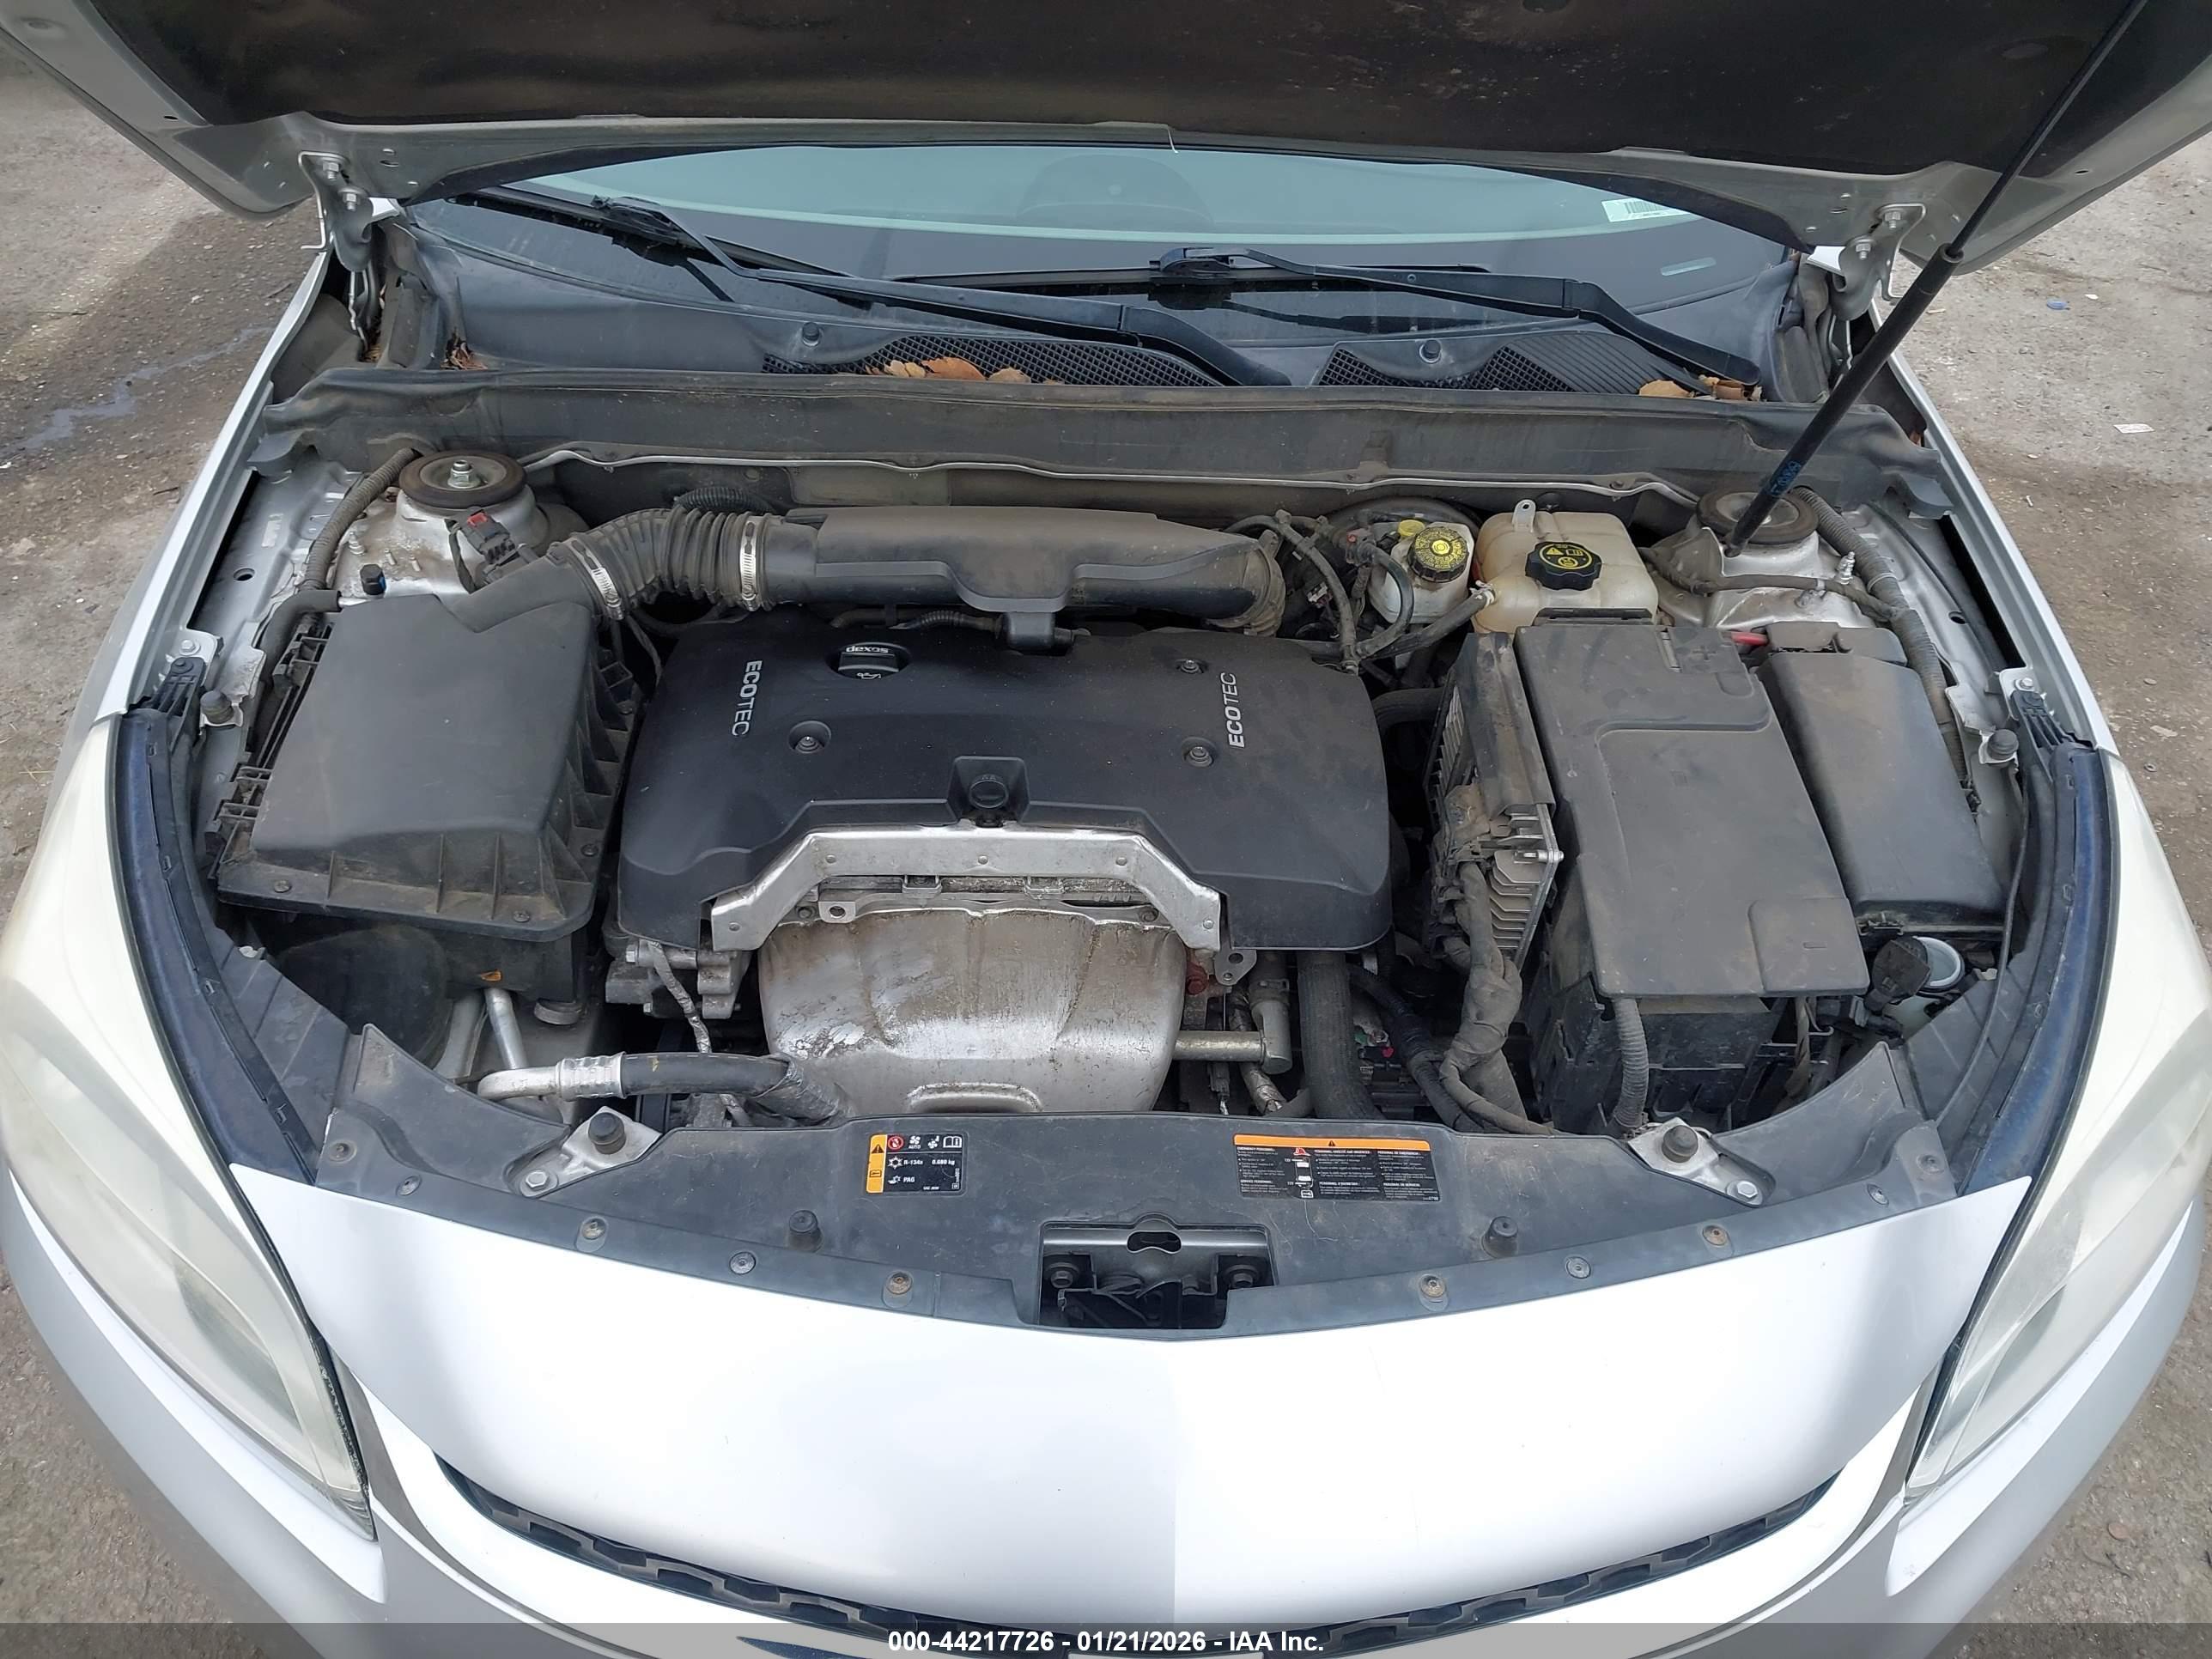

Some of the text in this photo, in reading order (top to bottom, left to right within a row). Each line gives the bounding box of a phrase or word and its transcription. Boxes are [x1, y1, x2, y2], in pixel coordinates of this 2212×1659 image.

[732, 660, 763, 736] ECOTEC
[1220, 672, 1244, 748] ECOTEC
[948, 1158, 956, 1166] kg
